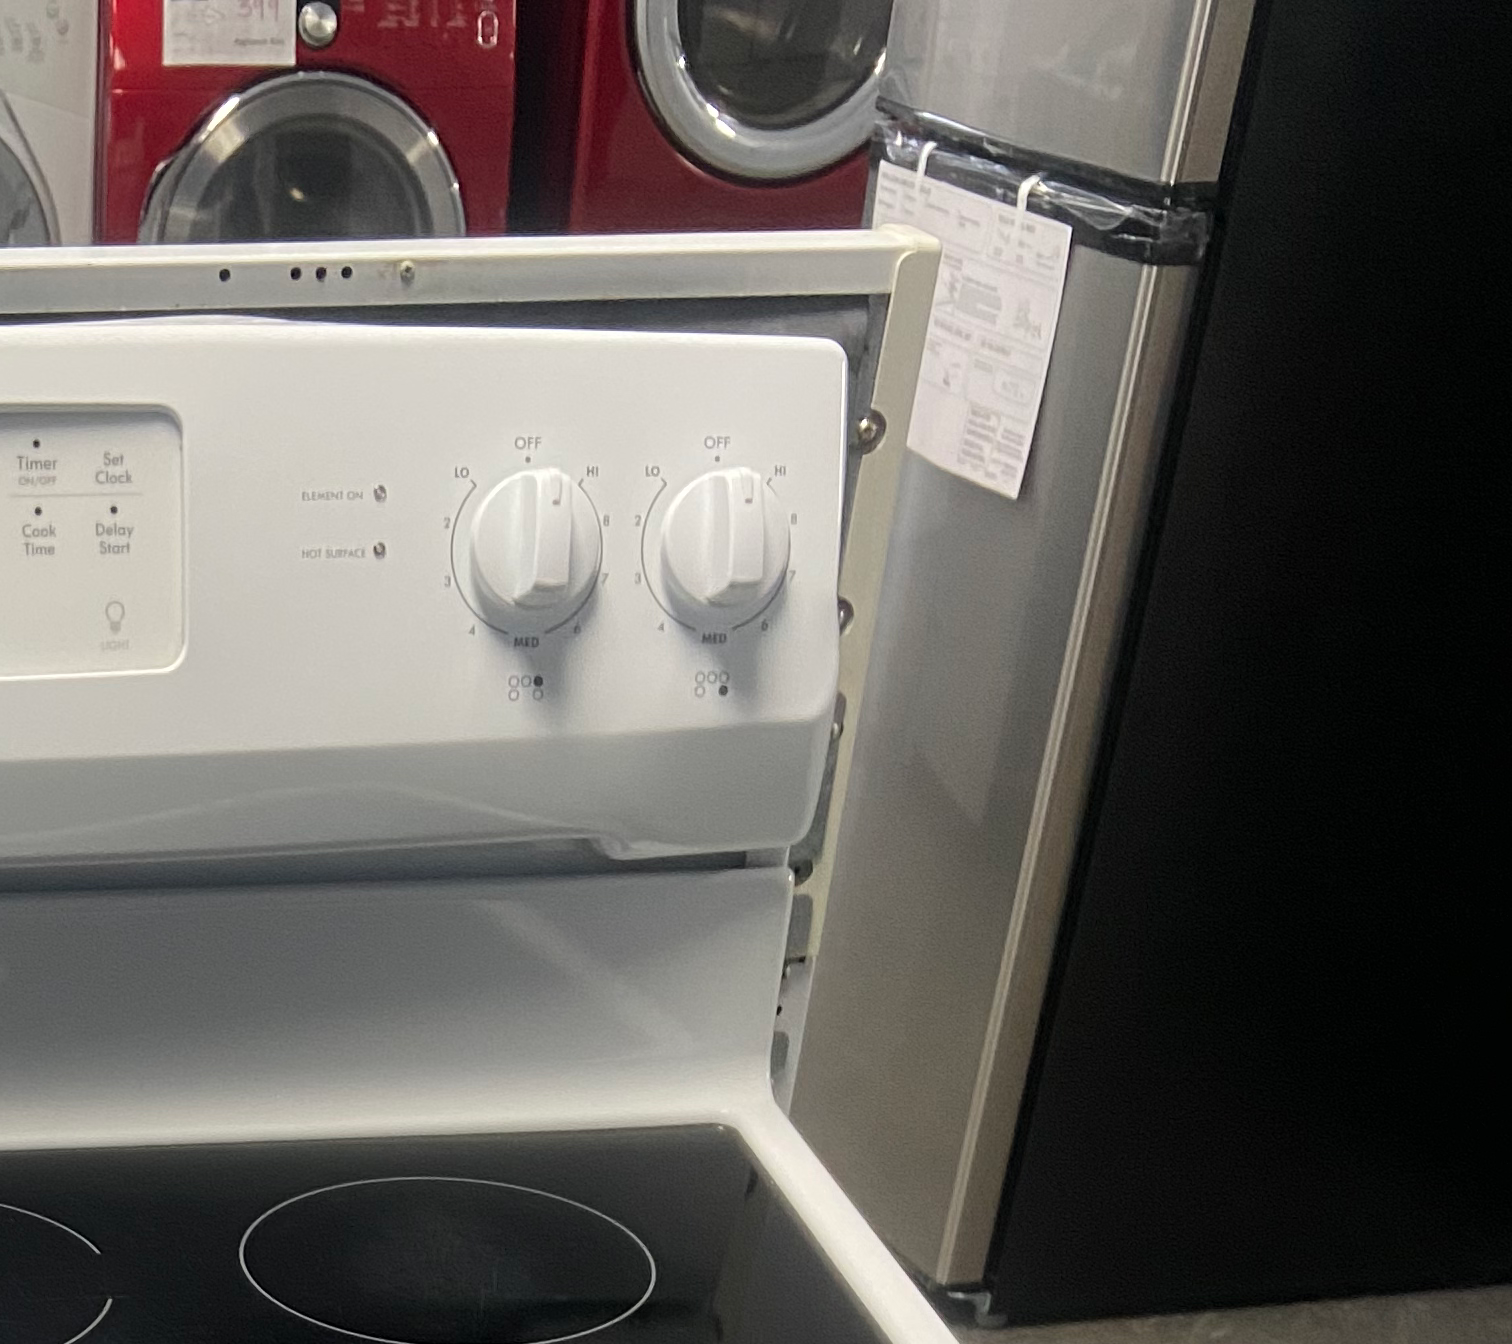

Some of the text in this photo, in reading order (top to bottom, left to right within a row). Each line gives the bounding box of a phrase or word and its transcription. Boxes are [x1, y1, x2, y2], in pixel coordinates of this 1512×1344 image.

[514, 436, 542, 450] OFF
[704, 436, 731, 450] OFF
[16, 455, 58, 471] Timer
[103, 451, 124, 466] Set
[95, 470, 133, 484] Clock
[454, 466, 470, 478] LO
[586, 466, 599, 477] HI
[645, 465, 660, 477] LO
[774, 465, 786, 477] HI
[443, 517, 451, 529] 2
[21, 523, 57, 538] Cook
[95, 522, 134, 539] Delay
[22, 542, 56, 557] Time
[99, 540, 131, 555] Start
[302, 549, 322, 559] HOT
[514, 637, 540, 648] MED
[702, 633, 727, 644] MED
